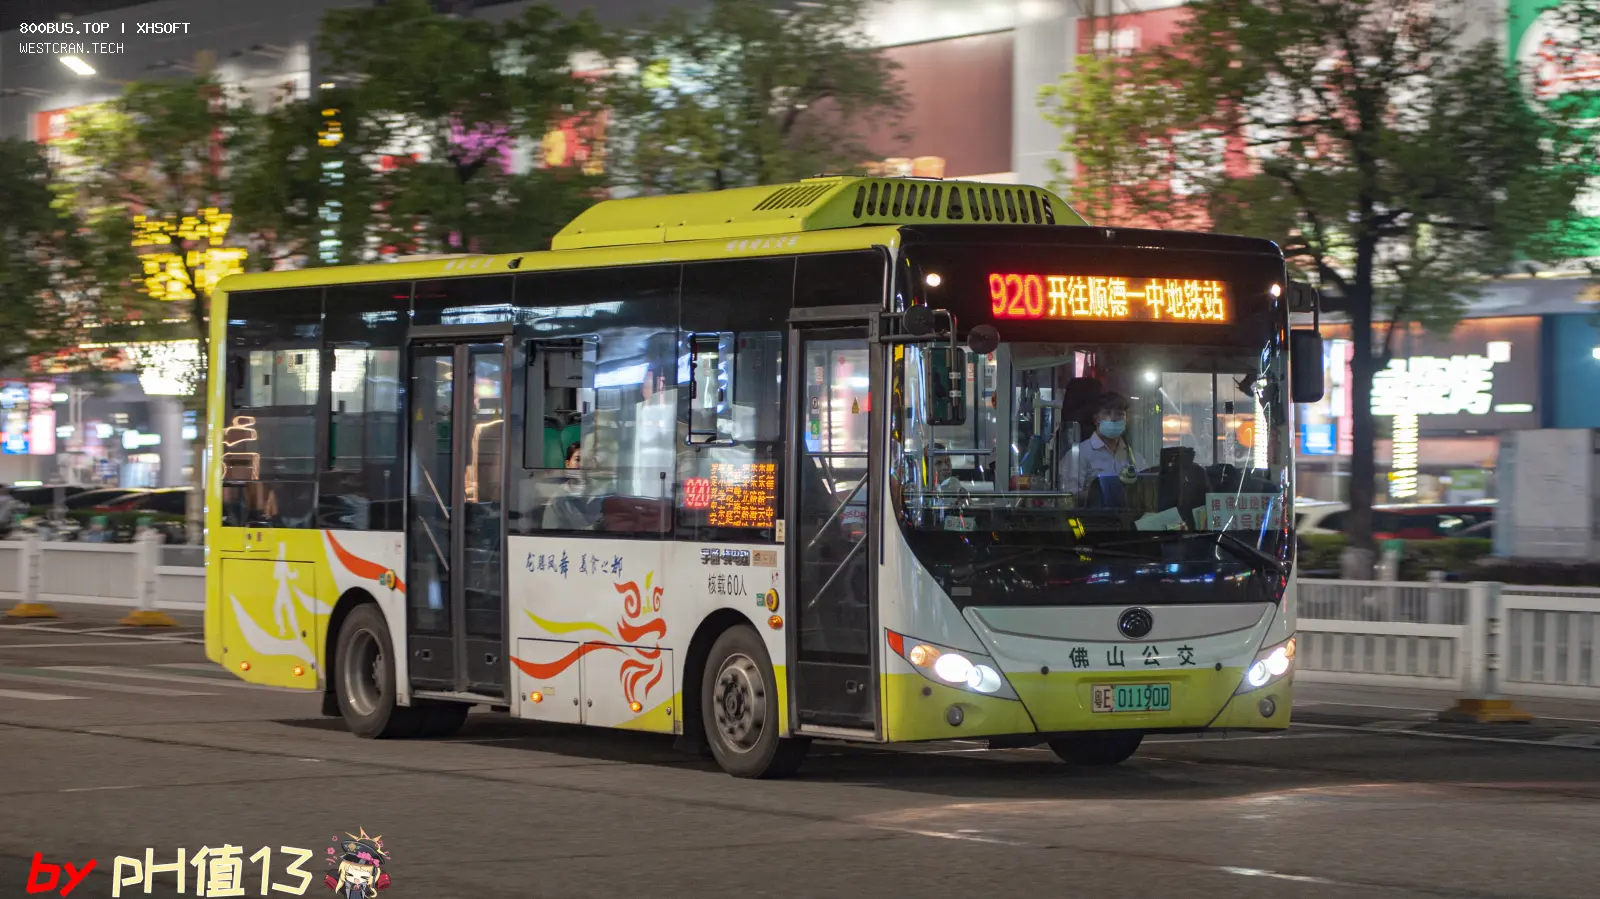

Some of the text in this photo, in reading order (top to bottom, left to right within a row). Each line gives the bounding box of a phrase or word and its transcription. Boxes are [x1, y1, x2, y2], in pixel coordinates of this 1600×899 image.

[988, 273, 1225, 321] 920 开往顺德一中地铁站
[1068, 644, 1197, 669] 佛山公交
